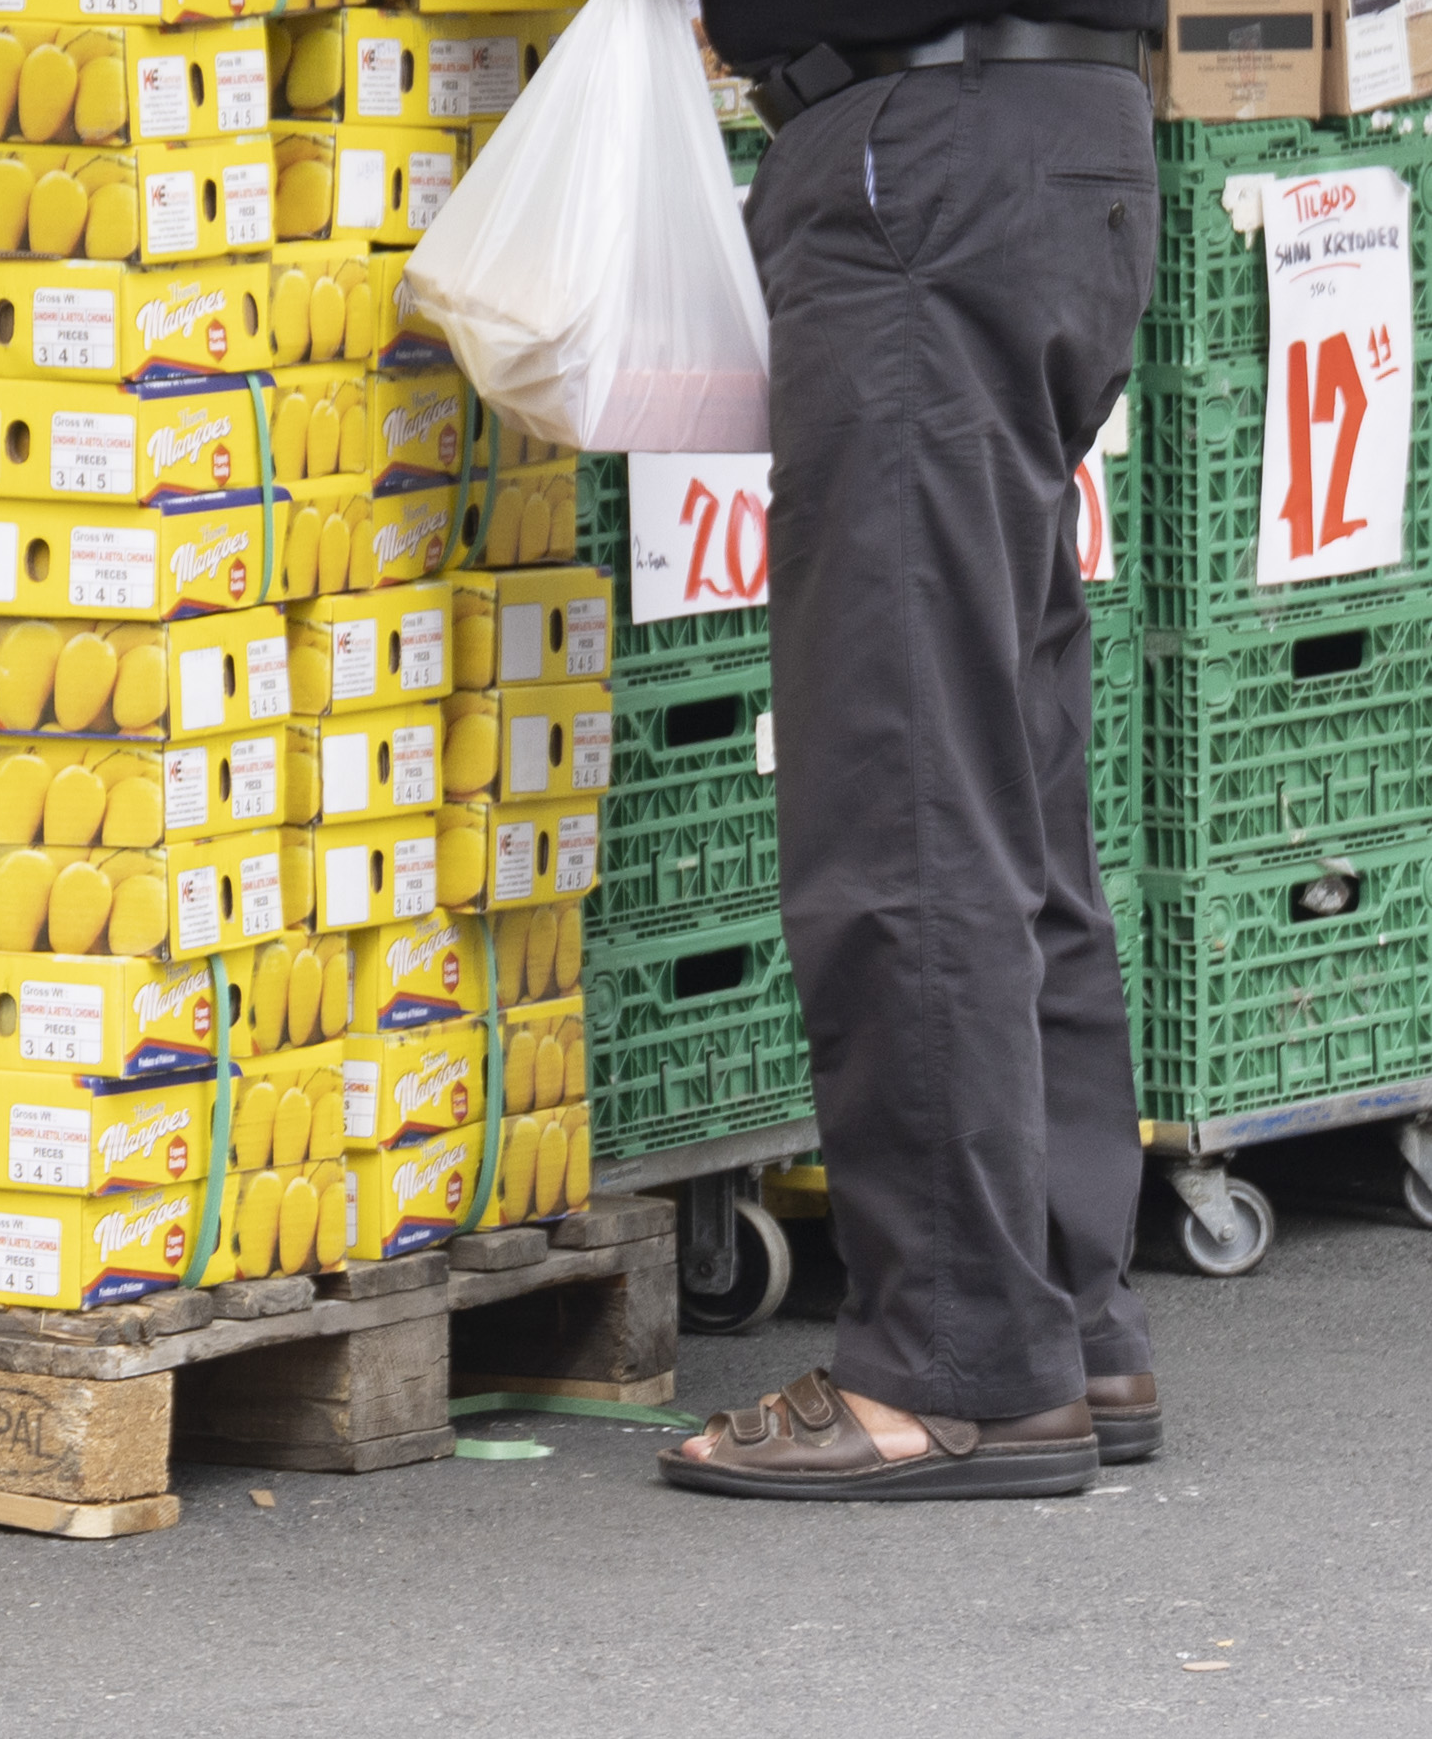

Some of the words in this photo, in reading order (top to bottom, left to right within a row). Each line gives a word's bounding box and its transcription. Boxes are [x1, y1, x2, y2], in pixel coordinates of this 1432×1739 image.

[1283, 179, 1356, 223] TILBUD
[1323, 226, 1399, 257] KRYDDER
[36, 292, 59, 304] Gross
[135, 286, 226, 344] Mangoes
[57, 330, 88, 341] PIECES
[38, 346, 48, 363] 3
[58, 346, 68, 363] 4
[79, 347, 89, 364] 5
[1279, 332, 1368, 560] 12
[680, 476, 768, 603] 20
